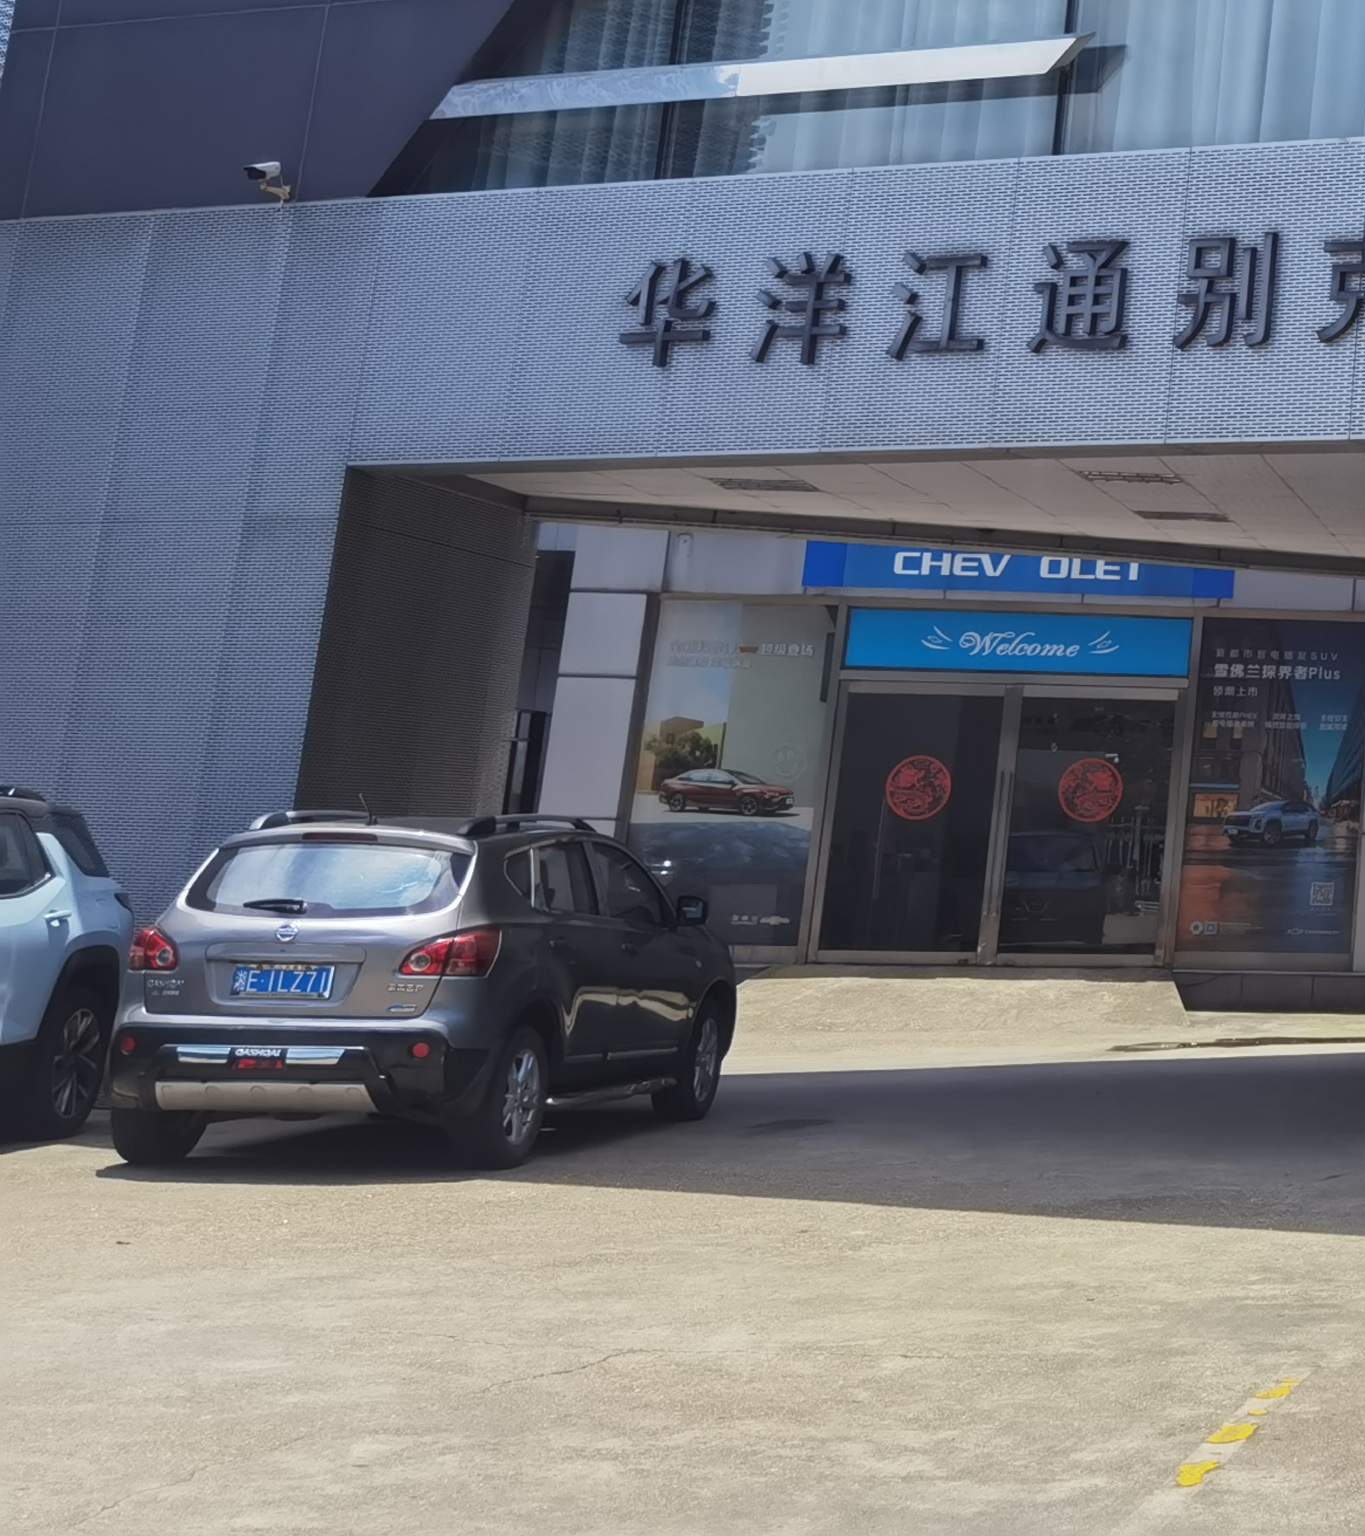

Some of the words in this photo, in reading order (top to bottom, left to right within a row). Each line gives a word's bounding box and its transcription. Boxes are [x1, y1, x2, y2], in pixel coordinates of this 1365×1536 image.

[959, 631, 1080, 657] Welcome
[1213, 663, 1341, 680] 雪佛兰探界者Plus
